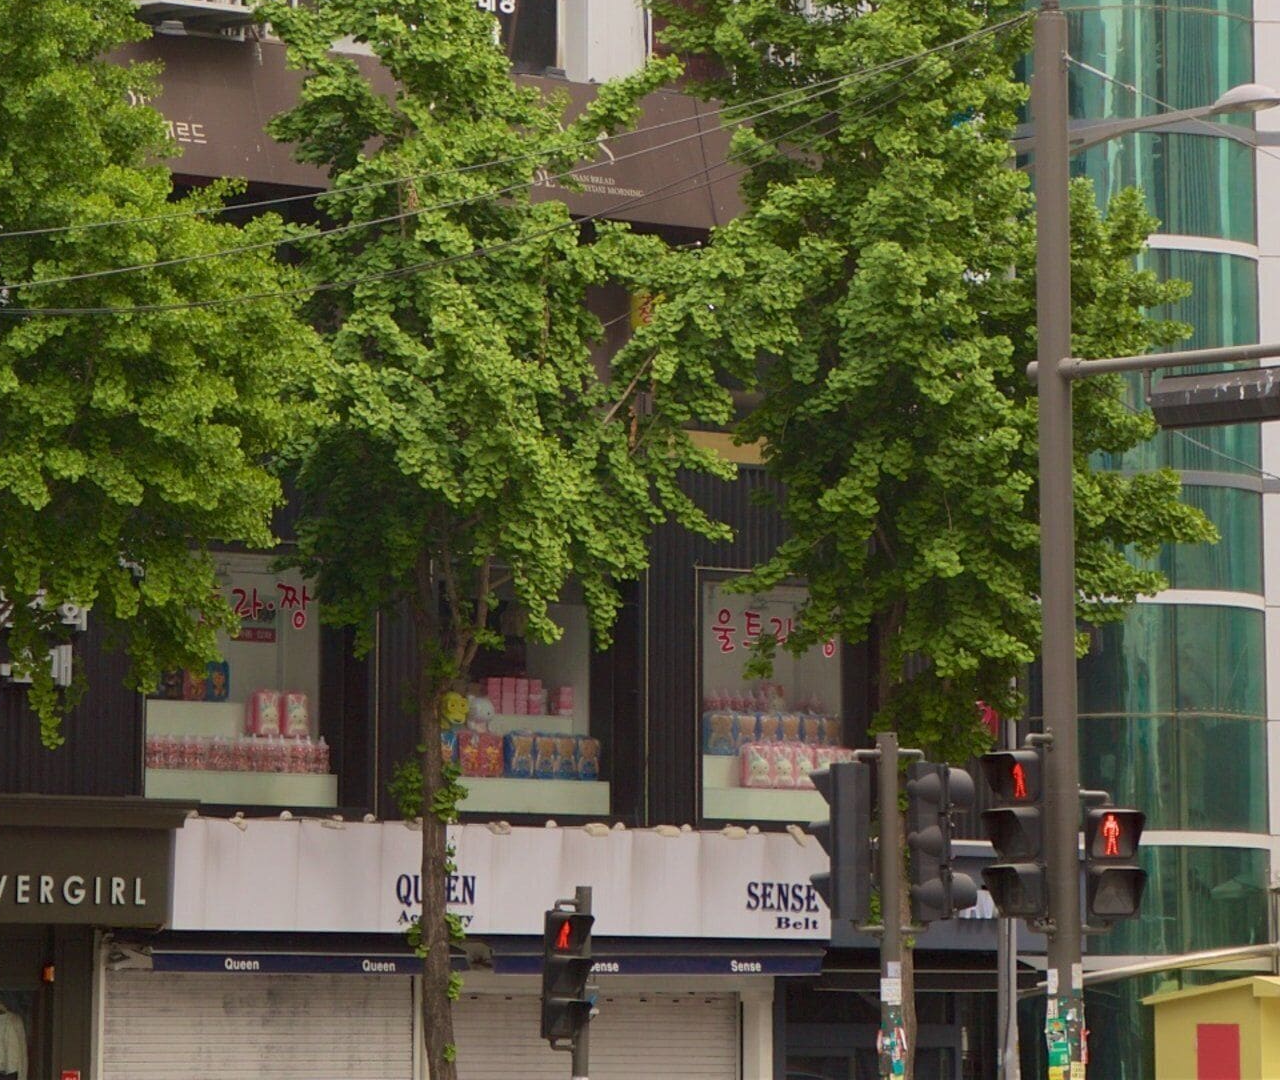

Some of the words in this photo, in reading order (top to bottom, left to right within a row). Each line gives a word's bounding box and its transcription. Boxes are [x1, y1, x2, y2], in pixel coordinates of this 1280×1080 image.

[746, 881, 819, 913] SENSE
[776, 916, 819, 931] Belt
[224, 957, 260, 972] Queen
[362, 959, 396, 974] Queen
[730, 960, 762, 972] Sense
